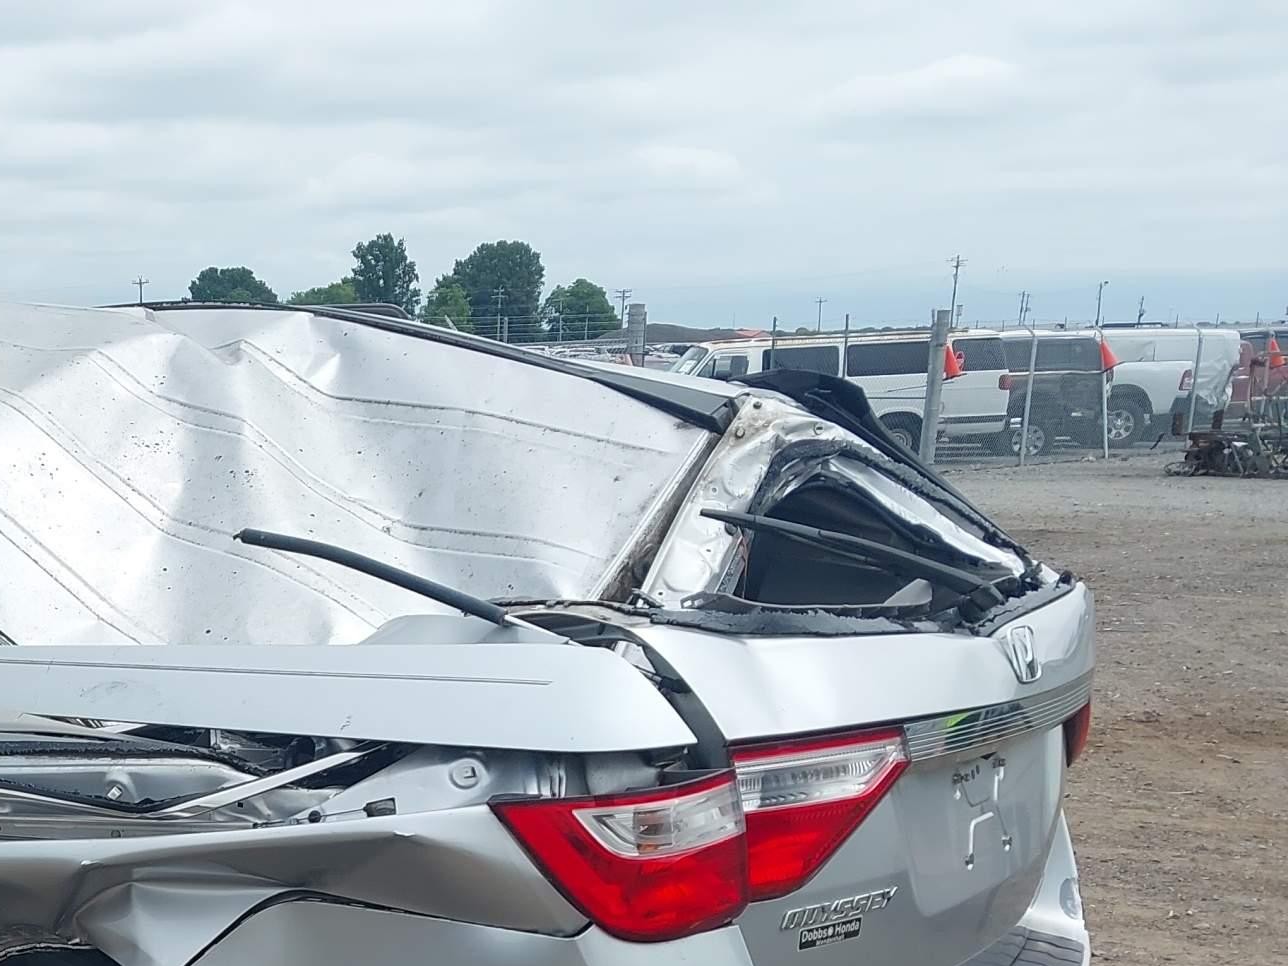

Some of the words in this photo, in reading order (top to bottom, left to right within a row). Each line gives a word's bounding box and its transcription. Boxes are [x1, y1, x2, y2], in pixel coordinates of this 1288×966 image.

[781, 886, 898, 930] ODYSSEY
[801, 926, 828, 943] Dobbs
[834, 919, 860, 935] Honda
